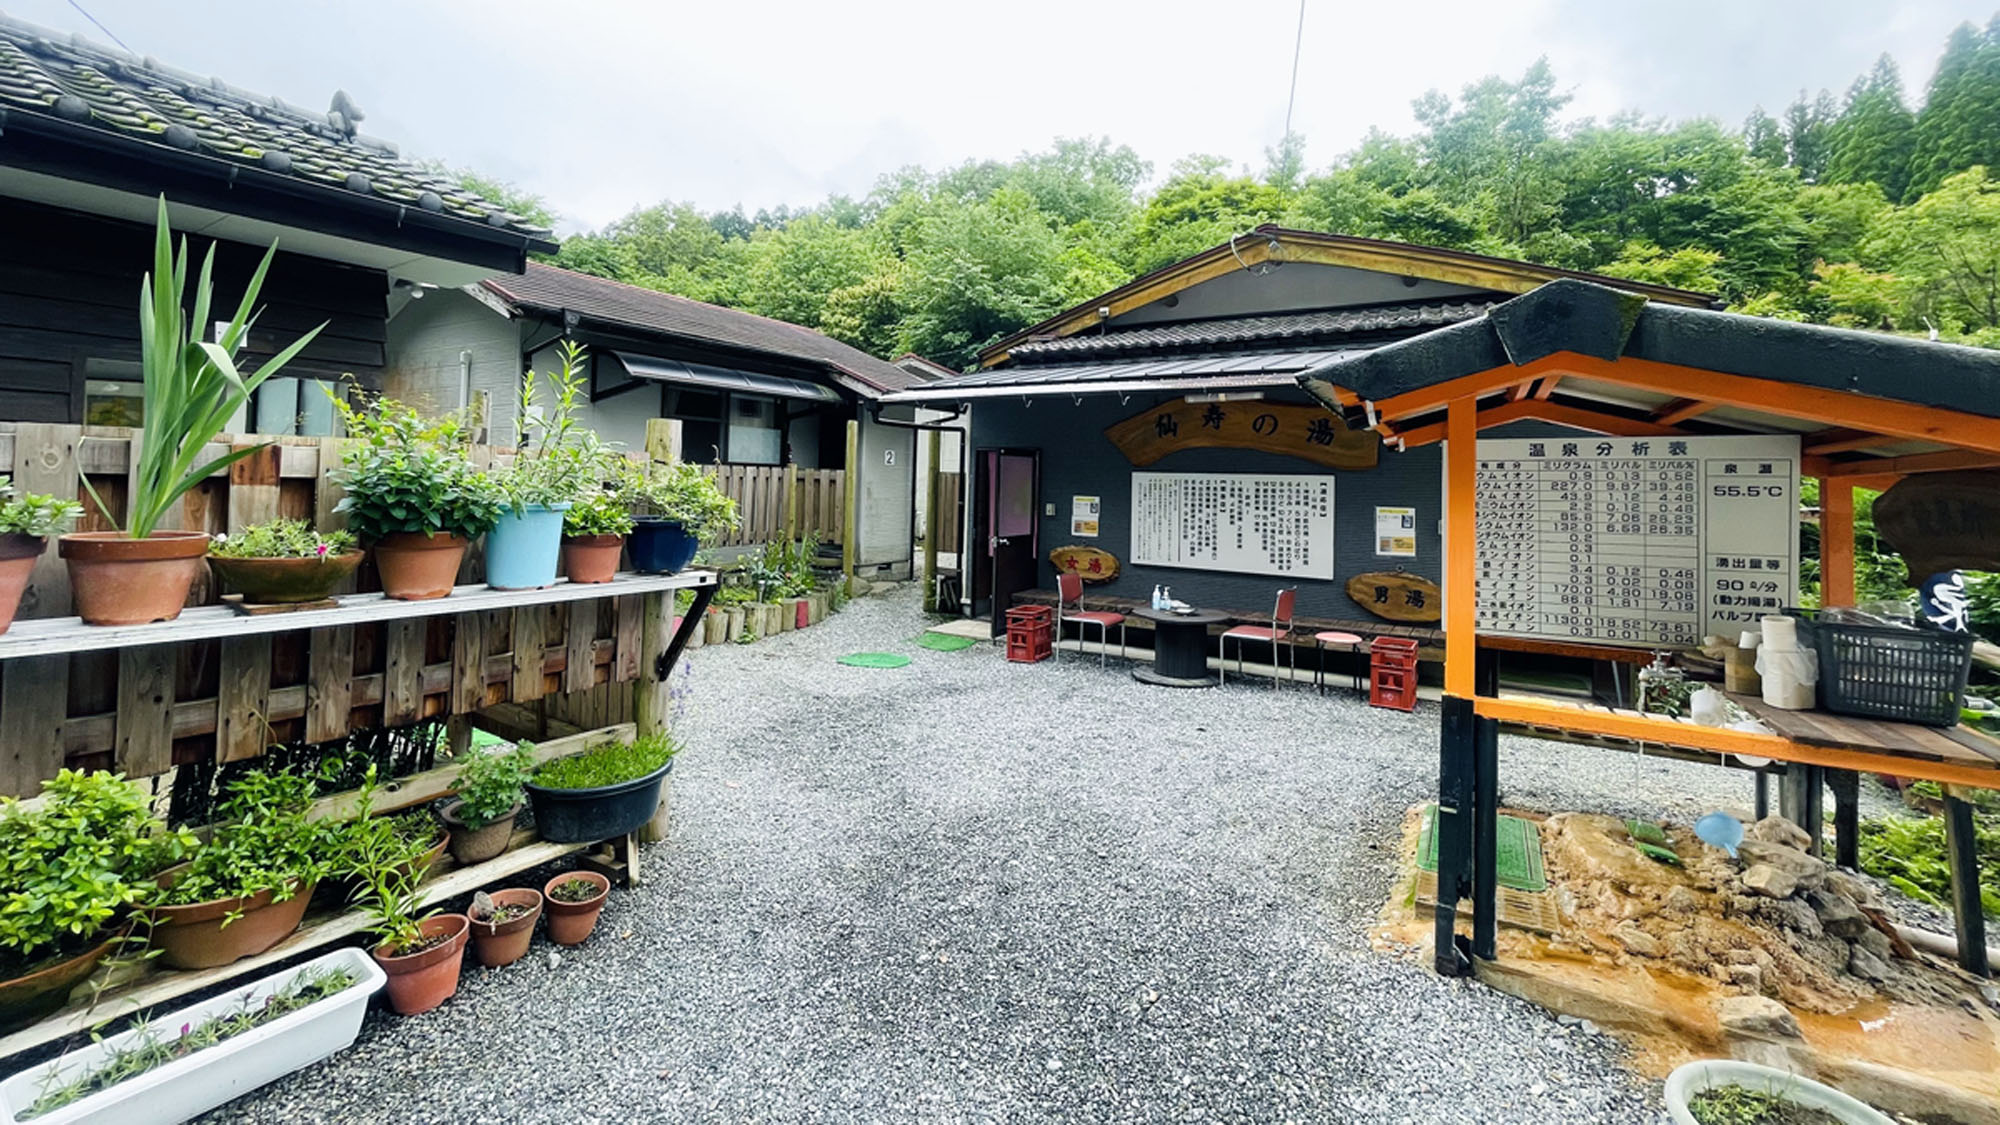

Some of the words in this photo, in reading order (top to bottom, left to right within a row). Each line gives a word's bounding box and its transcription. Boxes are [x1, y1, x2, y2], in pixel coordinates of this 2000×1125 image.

[1154, 403, 1335, 447] 仙寿の湯
[1529, 442, 1687, 457] 温泉分析表
[886, 452, 893, 465] 2
[1606, 472, 1640, 480] 0.13
[1551, 482, 1592, 490] 227.0
[1609, 493, 1640, 501] 1.12
[1569, 503, 1592, 511] 2.2
[1606, 503, 1640, 512] 0.12
[1553, 523, 1592, 531] 132.0
[1570, 534, 1592, 542] 0.2
[1570, 544, 1592, 552] 0.3
[1065, 556, 1102, 574] 女湯
[1716, 557, 1780, 570] 湧出量等
[1570, 565, 1592, 573] 3.4
[1607, 566, 1640, 575] 0.12
[1660, 569, 1694, 578] 0.48
[1570, 575, 1592, 584] 0.3
[1607, 577, 1640, 585] 0.02
[1716, 580, 1744, 591] 90
[1373, 585, 1426, 610] 男湯
[1554, 585, 1593, 594] 170.0
[1607, 588, 1640, 597] 4.80
[1652, 590, 1694, 600] 19.08
[1561, 595, 1593, 603] 86.8
[1610, 598, 1639, 607] 1.81
[1570, 606, 1591, 614] 0.1
[1545, 615, 1593, 625] 1130.0
[1600, 618, 1640, 628] 18.52
[1571, 626, 1593, 636] 0.3
[1608, 629, 1639, 639] 0.01
[1660, 633, 1694, 643] 0.04
